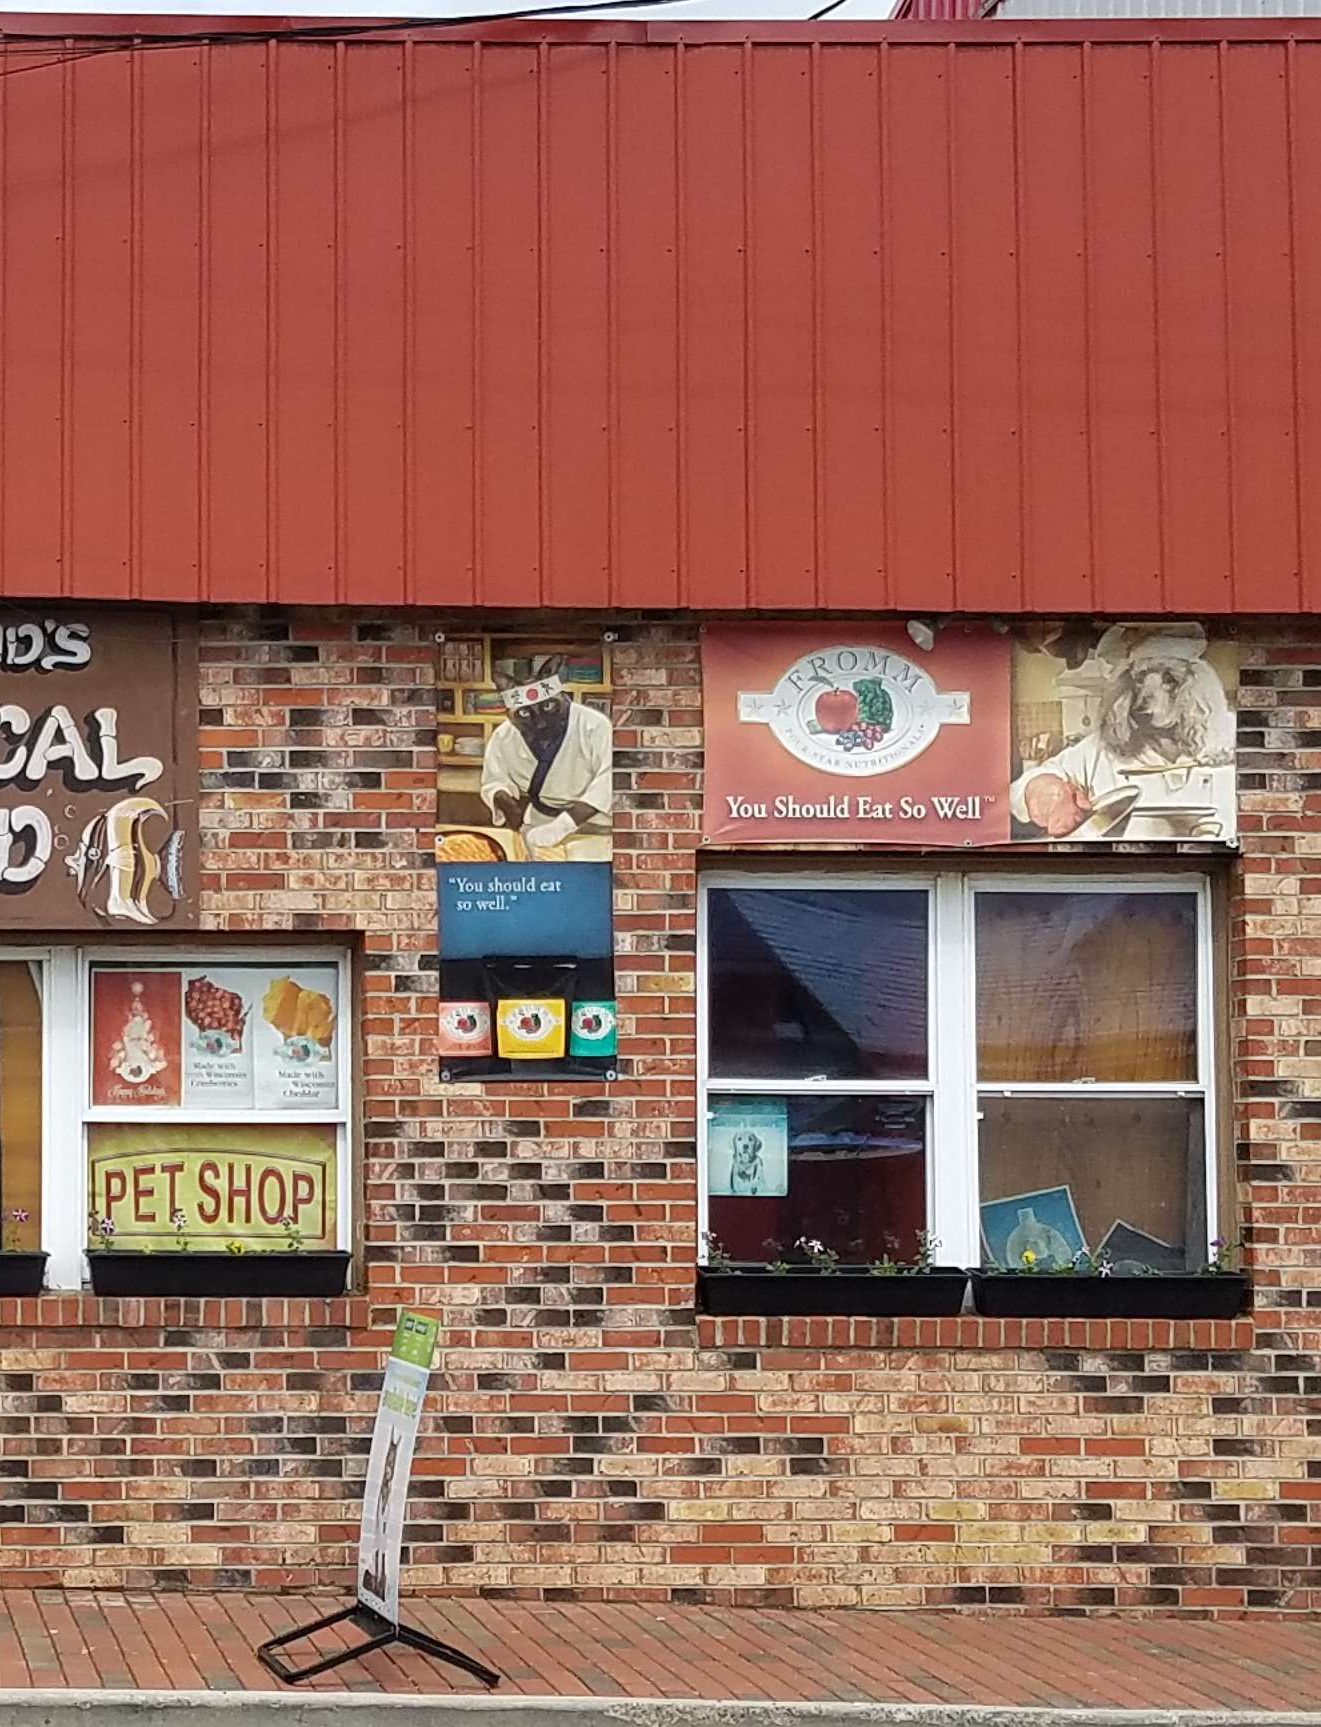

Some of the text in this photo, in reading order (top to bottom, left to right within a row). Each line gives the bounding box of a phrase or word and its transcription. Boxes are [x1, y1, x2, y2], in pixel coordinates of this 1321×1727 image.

[786, 650, 923, 693] FROMM
[813, 750, 841, 767] STAR
[726, 796, 768, 819] You
[774, 795, 850, 819] Should
[856, 796, 893, 819] Eat
[899, 796, 926, 819] So
[487, 876, 536, 893] should
[540, 880, 562, 892] eat
[456, 900, 472, 911] so
[105, 1159, 315, 1225] PET SHOP
